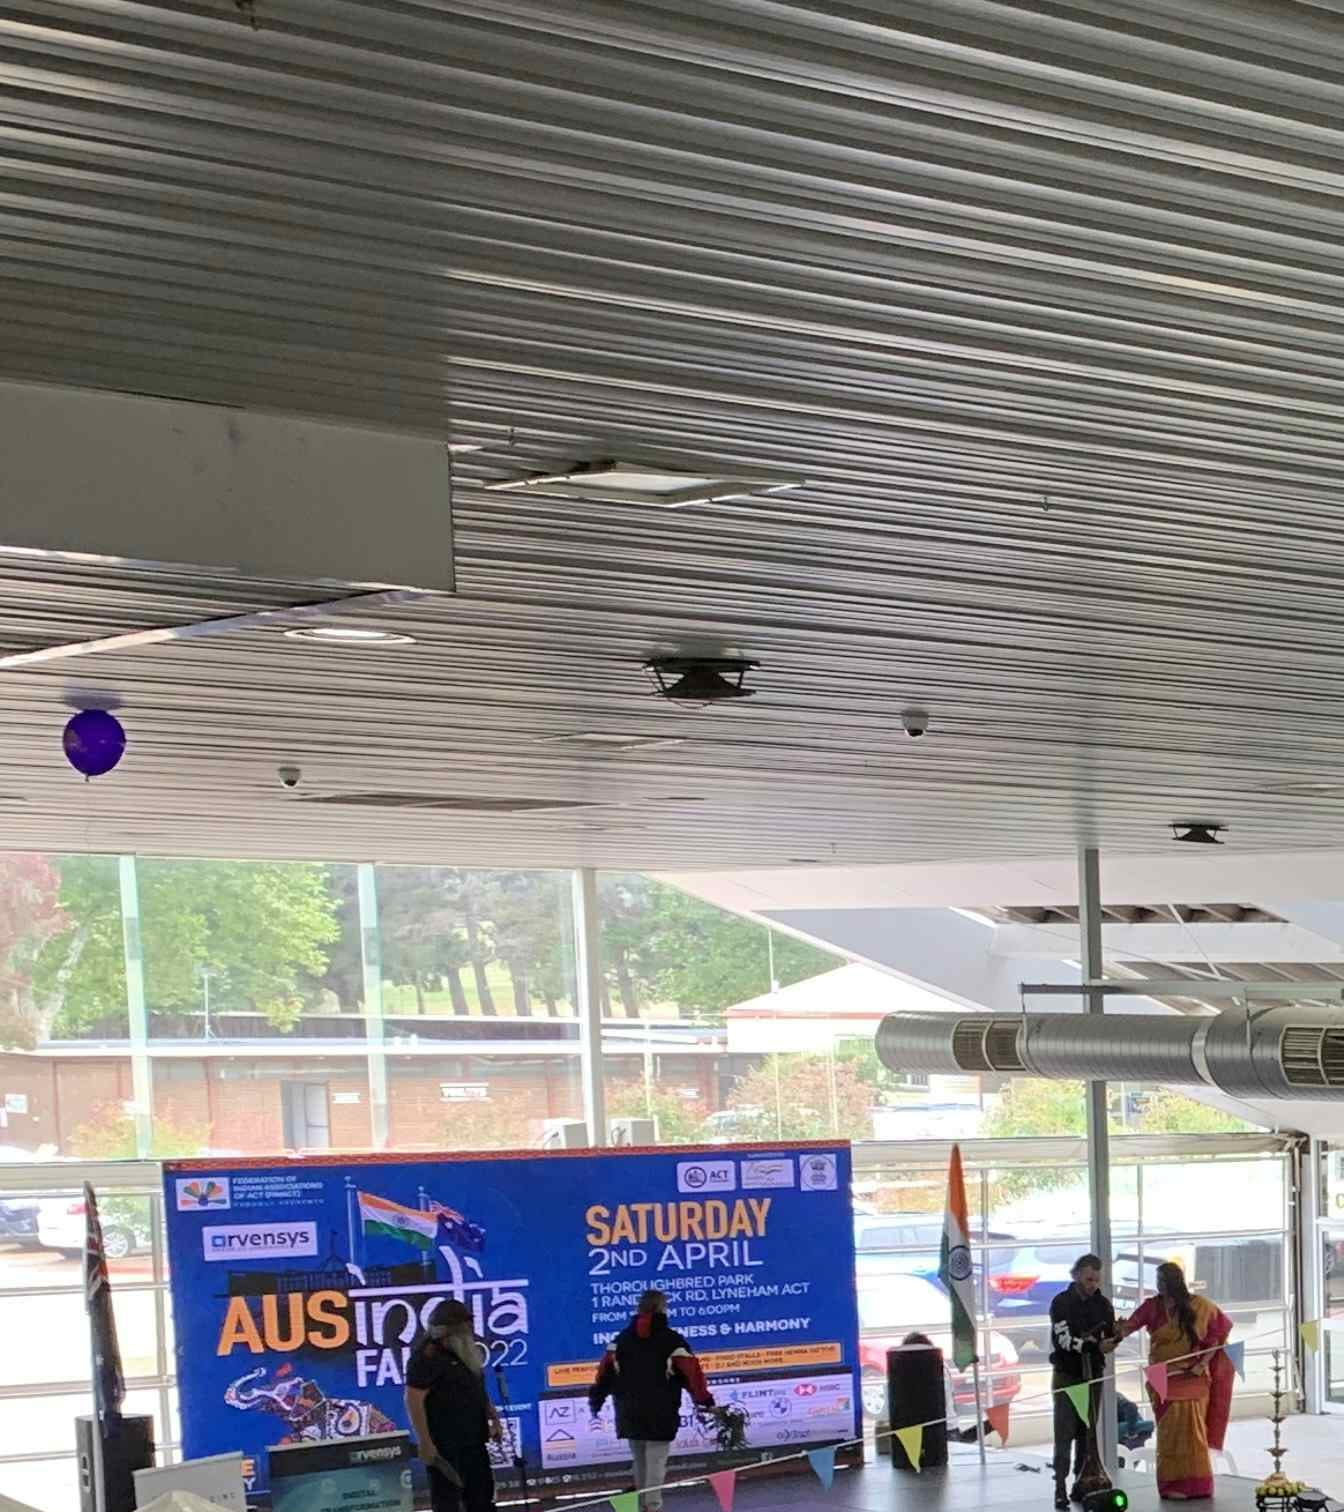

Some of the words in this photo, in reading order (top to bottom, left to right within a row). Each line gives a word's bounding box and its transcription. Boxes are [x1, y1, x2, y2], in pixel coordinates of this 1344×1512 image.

[710, 1170, 728, 1180] ACT
[586, 1198, 771, 1246] SATURDAY
[588, 1248, 648, 1276] 2ND
[657, 1240, 764, 1272] APRIL
[591, 1276, 715, 1296] THOROUGHBRED
[718, 1273, 754, 1286] PARK
[592, 1297, 599, 1308] 1
[712, 1284, 779, 1301] LYNEHAM
[781, 1282, 811, 1295] ACT
[592, 1311, 627, 1324] FROM
[680, 1306, 697, 1318] TO
[734, 1317, 812, 1336] HARMONY
